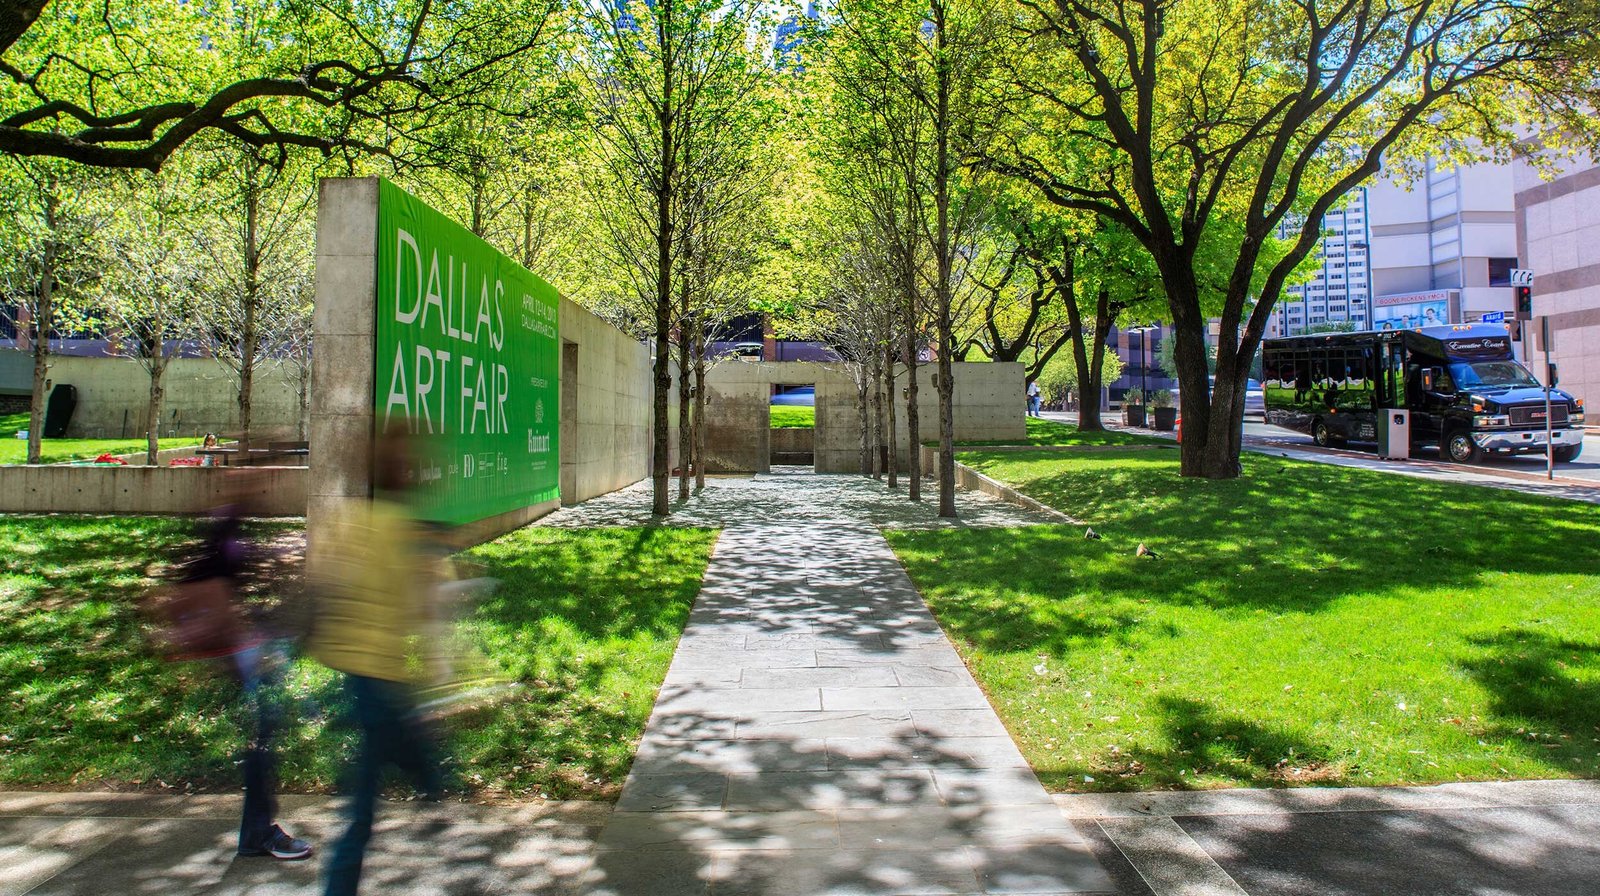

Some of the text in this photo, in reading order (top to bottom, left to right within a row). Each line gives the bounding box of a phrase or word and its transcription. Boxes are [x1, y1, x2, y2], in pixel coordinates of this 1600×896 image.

[395, 227, 505, 352] DALLAS
[382, 340, 509, 435] ART FAIR
[1449, 338, 1505, 351] Executive Coach
